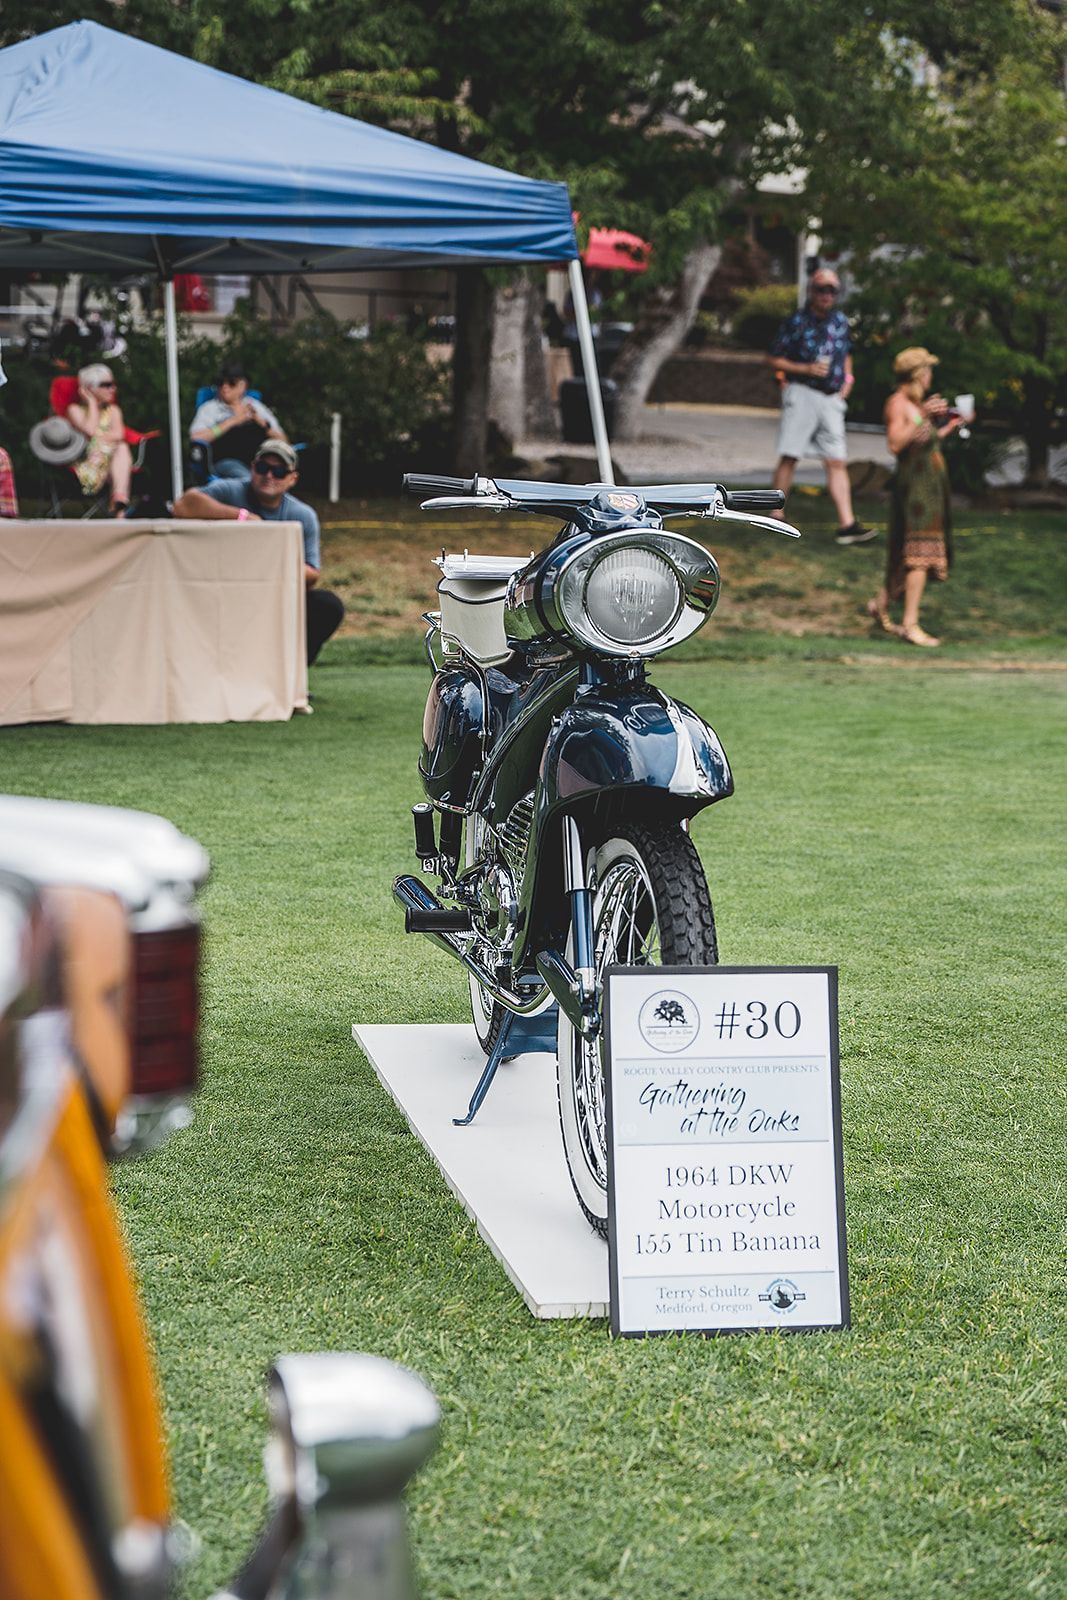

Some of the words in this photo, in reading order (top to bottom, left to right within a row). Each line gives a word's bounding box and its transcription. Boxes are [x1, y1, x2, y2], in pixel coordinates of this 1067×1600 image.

[714, 1000, 801, 1039] #30
[624, 1067, 657, 1076] ROGUE
[660, 1066, 695, 1075] VALLEY
[697, 1065, 743, 1074] COUNTRY
[745, 1065, 771, 1074] CLUB
[772, 1064, 820, 1073] PRESENTS
[639, 1079, 746, 1115] Gathering
[680, 1107, 708, 1135] at
[708, 1107, 739, 1137] the
[748, 1108, 800, 1133] Oaks
[666, 1166, 719, 1187] 1964
[729, 1164, 793, 1186] DKW
[658, 1196, 796, 1224] Motorcycle
[635, 1234, 672, 1255] 155
[679, 1232, 722, 1253] Tin
[732, 1231, 821, 1252] Banana
[656, 1286, 695, 1300] Terry
[699, 1284, 750, 1298] Schultz
[655, 1303, 708, 1314] Medford,
[710, 1303, 753, 1314] Oregon
